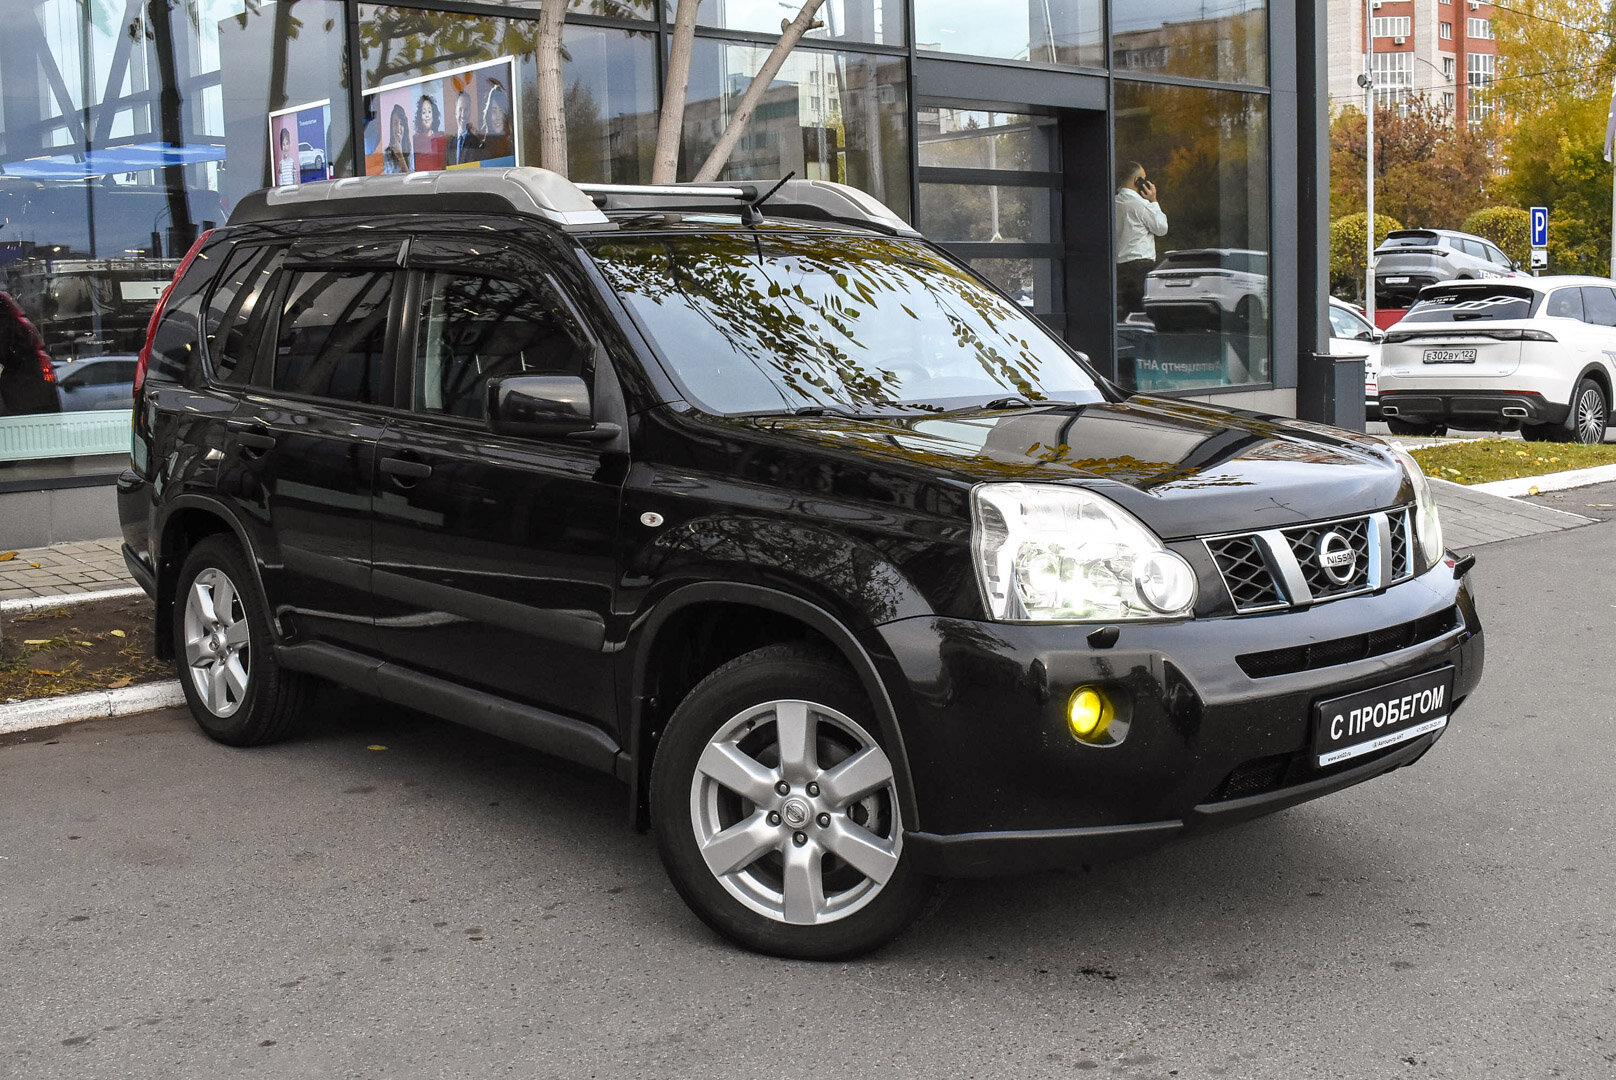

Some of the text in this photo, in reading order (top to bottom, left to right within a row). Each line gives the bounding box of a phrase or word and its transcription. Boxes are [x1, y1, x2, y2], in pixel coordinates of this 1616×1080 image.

[1535, 211, 1545, 243] P
[1326, 552, 1355, 564] NISSAN
[1330, 684, 1445, 740] С ПРОБЕГОМ
